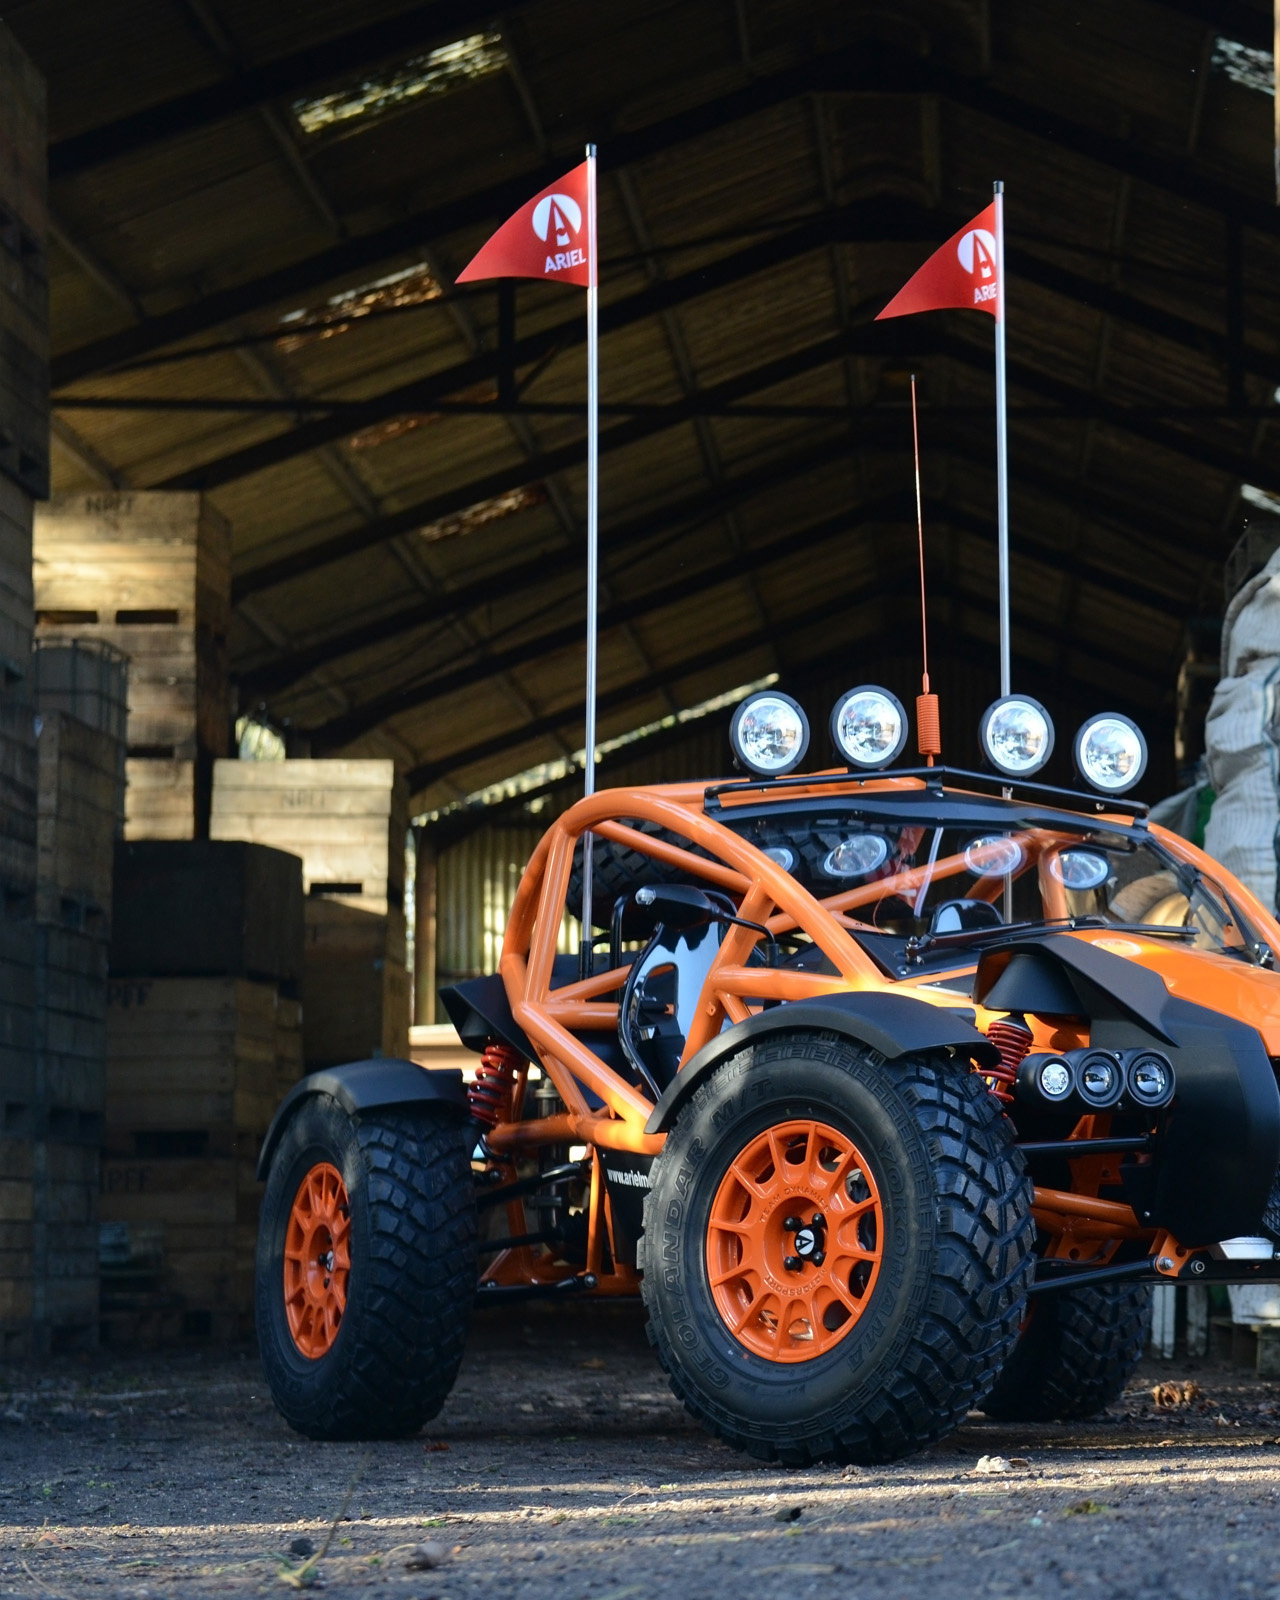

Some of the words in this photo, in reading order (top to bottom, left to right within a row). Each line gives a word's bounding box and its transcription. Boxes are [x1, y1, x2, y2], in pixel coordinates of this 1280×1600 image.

[544, 247, 587, 274] ARIEL
[973, 281, 997, 304] ARIE
[662, 1136, 731, 1390] GEOLANDAR
